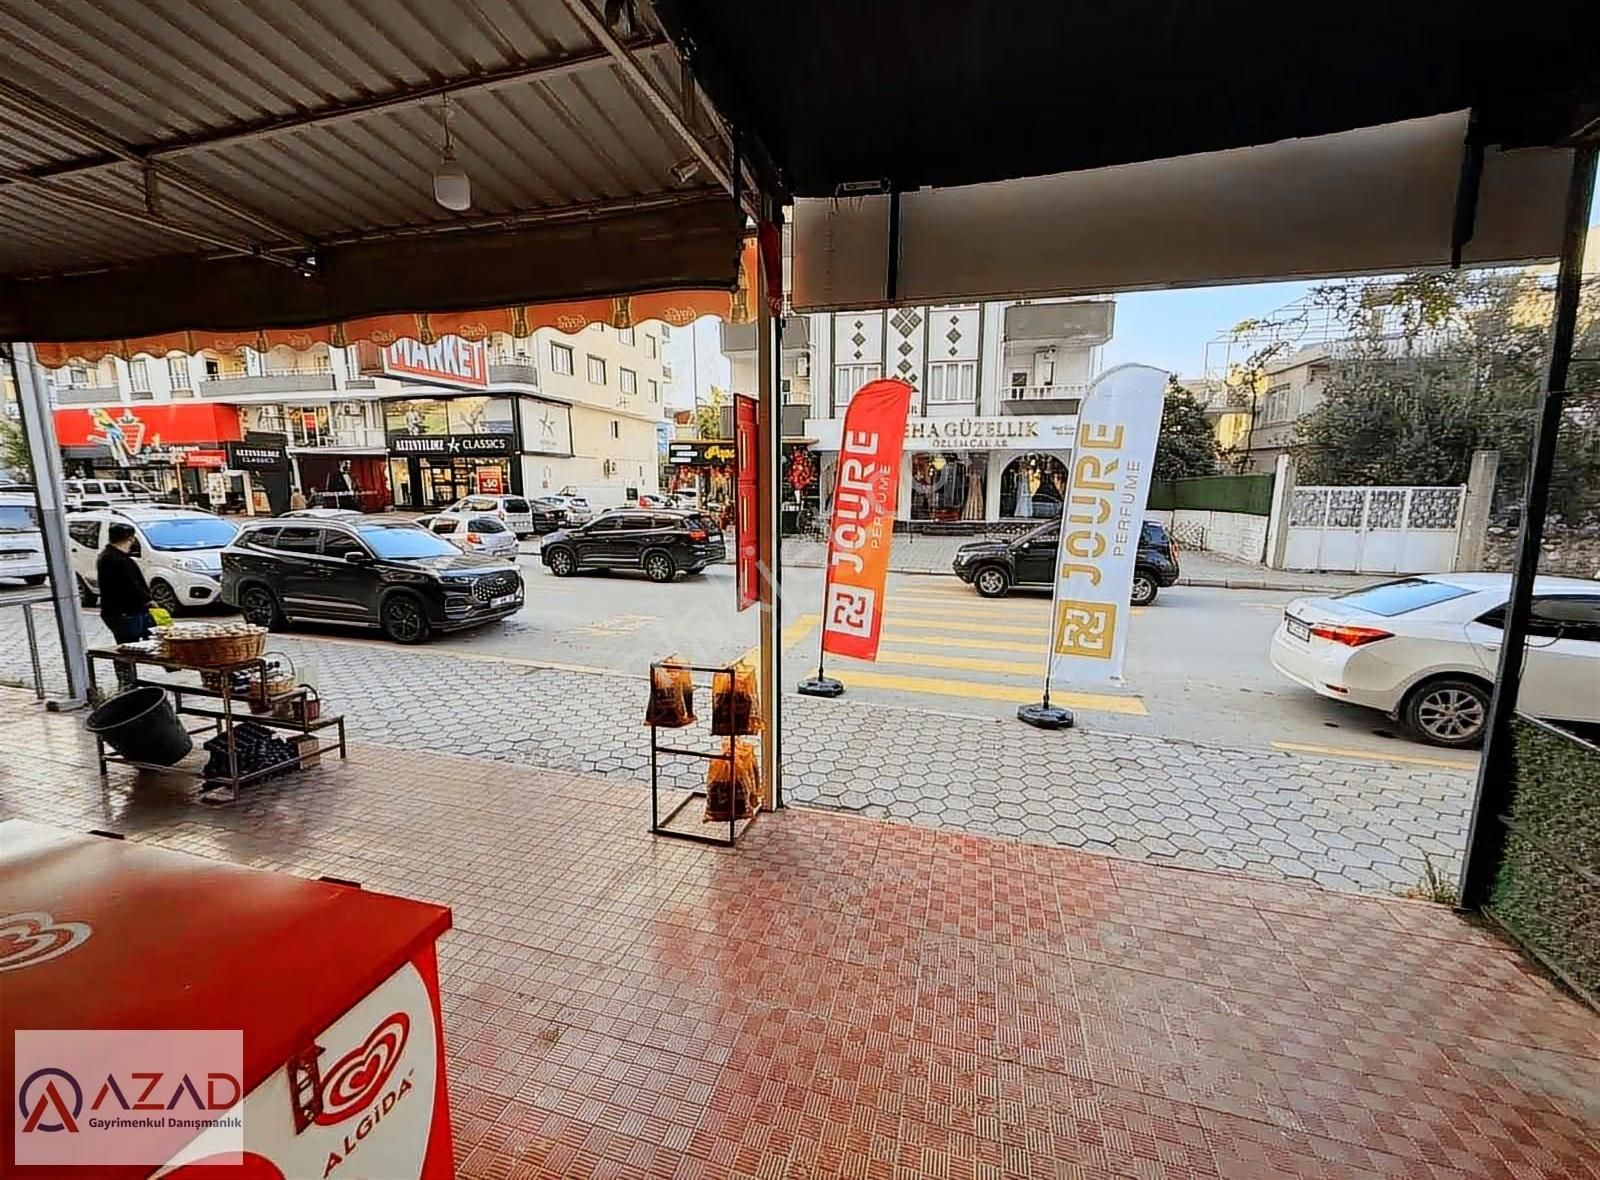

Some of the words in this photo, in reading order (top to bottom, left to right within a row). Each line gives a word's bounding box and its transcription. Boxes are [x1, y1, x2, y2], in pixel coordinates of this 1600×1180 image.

[390, 336, 483, 379] MARKET
[463, 439, 506, 449] CLASSICS
[831, 430, 879, 575] JOURE
[871, 463, 891, 549] PERFUME
[1062, 423, 1125, 586] JOURE
[1113, 459, 1142, 557] PERFUME
